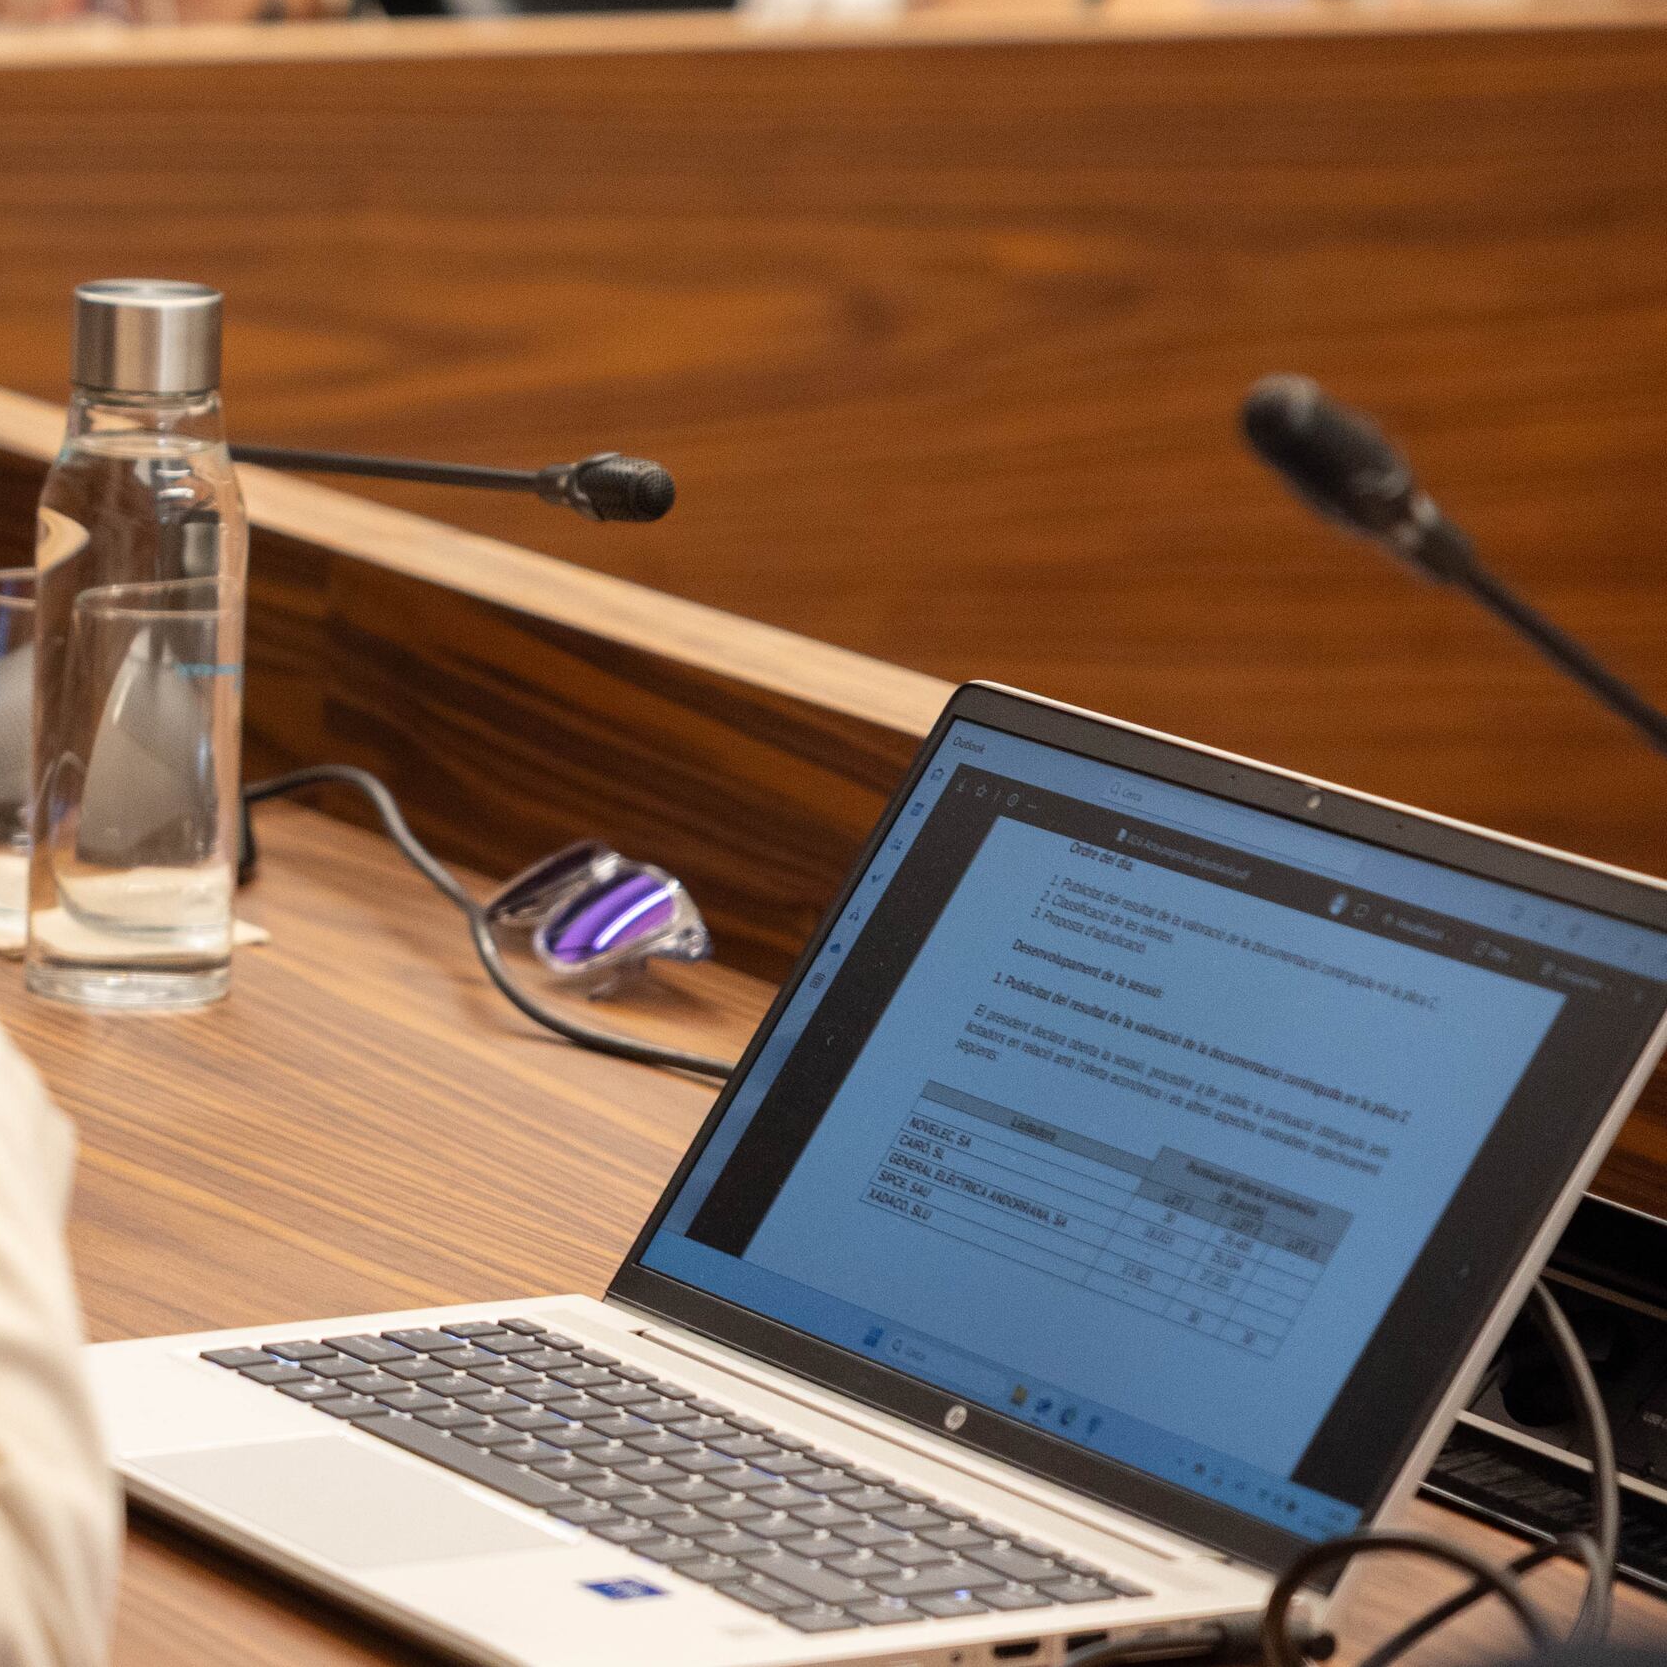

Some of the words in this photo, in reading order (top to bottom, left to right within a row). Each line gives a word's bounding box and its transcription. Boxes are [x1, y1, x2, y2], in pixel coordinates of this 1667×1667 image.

[951, 736, 985, 753] Outlook
[1068, 842, 1099, 859] Ordre
[1097, 852, 1118, 864] del
[1051, 894, 1110, 921] Classificació
[1060, 877, 1105, 900] Publicitat
[1102, 893, 1121, 905] del
[1120, 899, 1157, 917] resultat
[1041, 910, 1085, 933] Proposta
[1012, 939, 1101, 976] Desenvolupament
[1099, 970, 1116, 982] de
[1114, 974, 1127, 987] la
[1003, 976, 1052, 1000] Publicitat
[1050, 993, 1070, 1005] del
[1068, 1000, 1108, 1019] resultat
[1106, 1012, 1123, 1025] de
[1121, 1016, 1134, 1029] la
[972, 1003, 987, 1017] El
[984, 1011, 1031, 1032] president
[1030, 1025, 1067, 1045] declara
[964, 1021, 1006, 1043] licitadors
[1005, 1037, 1021, 1047] en
[1020, 1042, 1053, 1059] relació
[955, 1134, 972, 1147] SA
[888, 1152, 932, 1177] GENERAL
